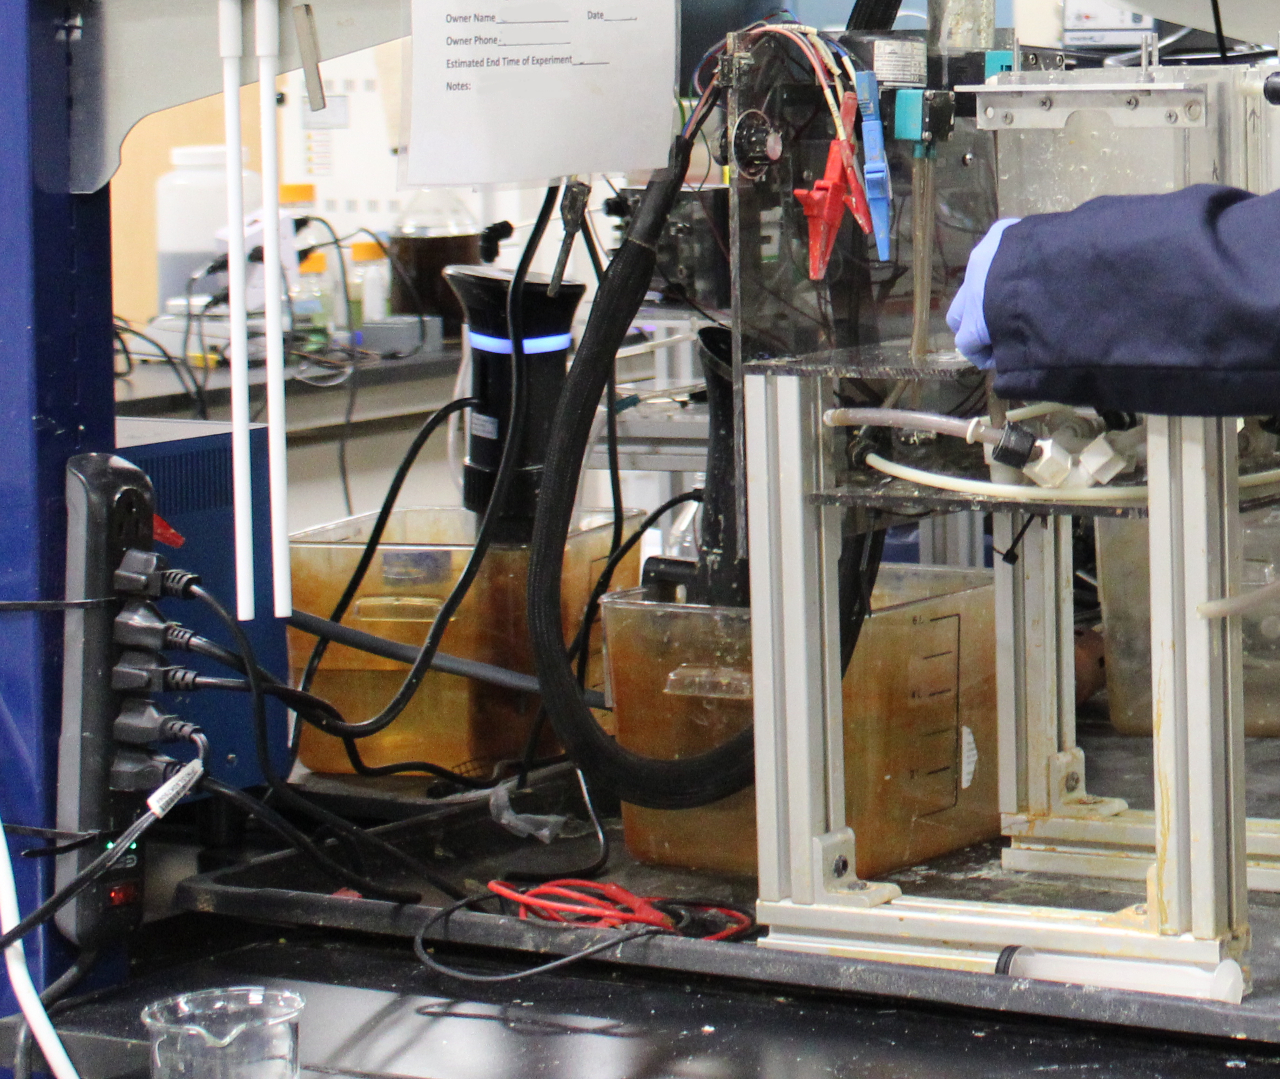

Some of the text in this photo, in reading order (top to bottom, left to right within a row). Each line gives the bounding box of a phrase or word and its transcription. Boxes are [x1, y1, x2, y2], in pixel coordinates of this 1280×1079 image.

[446, 13, 496, 23] Owner Name
[587, 11, 604, 20] Date
[446, 35, 498, 46] Owner Phone
[446, 54, 573, 68] Estimated End Time of Experiment
[446, 81, 472, 91] Notes:
